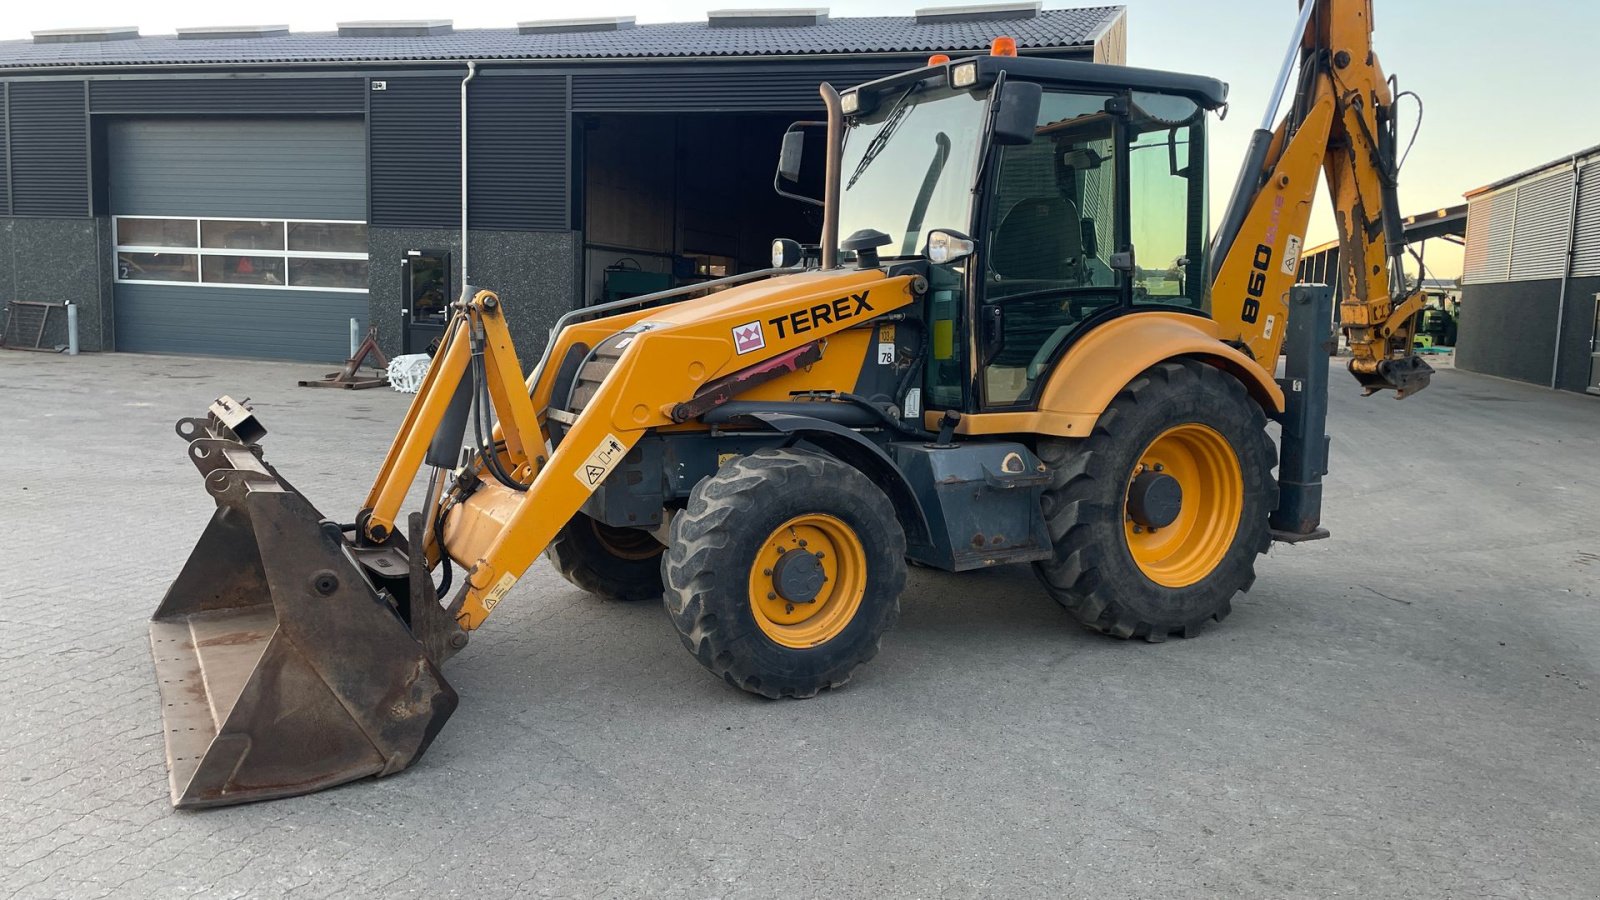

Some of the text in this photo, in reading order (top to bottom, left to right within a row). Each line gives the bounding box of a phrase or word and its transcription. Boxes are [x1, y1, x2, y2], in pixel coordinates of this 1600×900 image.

[1241, 243, 1272, 324] 860
[768, 289, 874, 339] TEREX
[881, 352, 892, 363] 78
